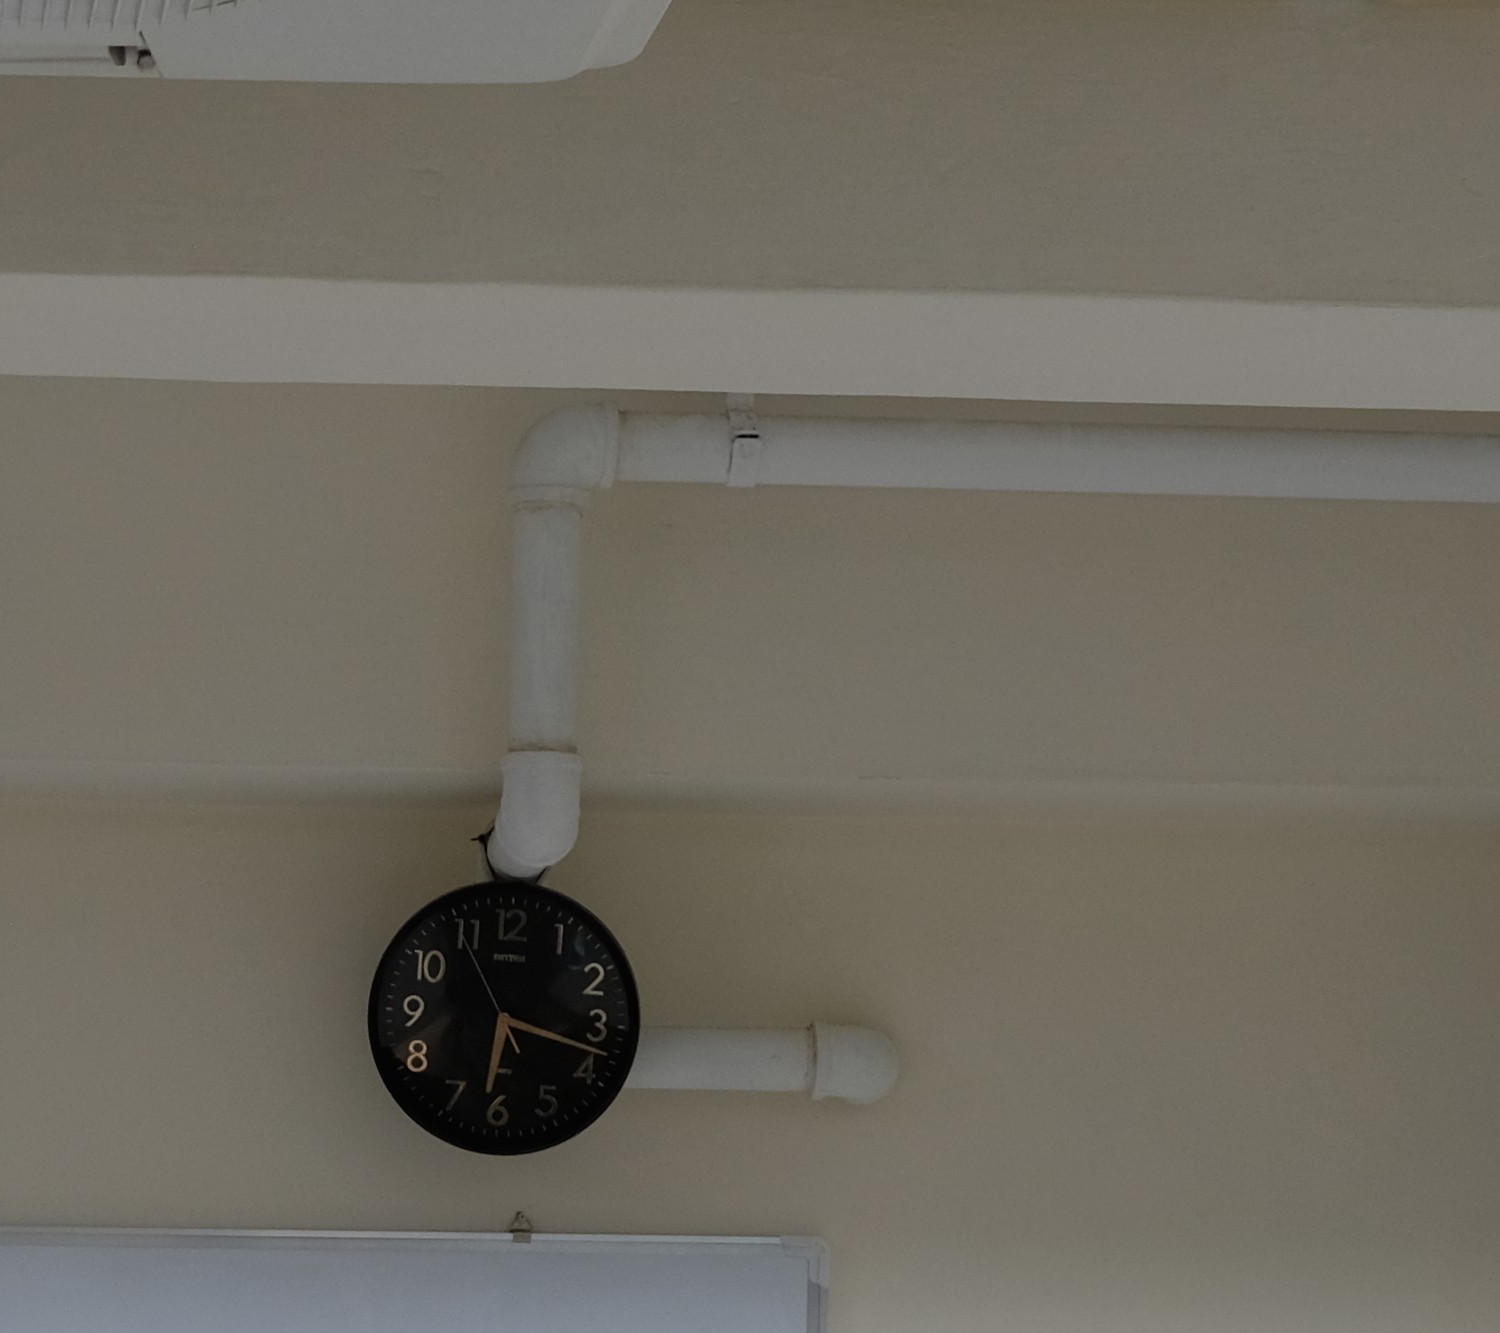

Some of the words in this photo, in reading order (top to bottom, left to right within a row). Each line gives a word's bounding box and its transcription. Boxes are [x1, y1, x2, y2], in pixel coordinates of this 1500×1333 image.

[455, 918, 480, 949] 11
[496, 908, 527, 942] 12
[554, 923, 565, 955] 1
[415, 949, 446, 983] 10
[582, 963, 606, 996] 2
[403, 994, 425, 1027] 9
[586, 1008, 607, 1042] 3
[406, 1039, 428, 1072] 8
[573, 1053, 596, 1084] 4
[445, 1080, 467, 1111] 7
[486, 1094, 509, 1126] 6
[535, 1085, 558, 1116] 5
